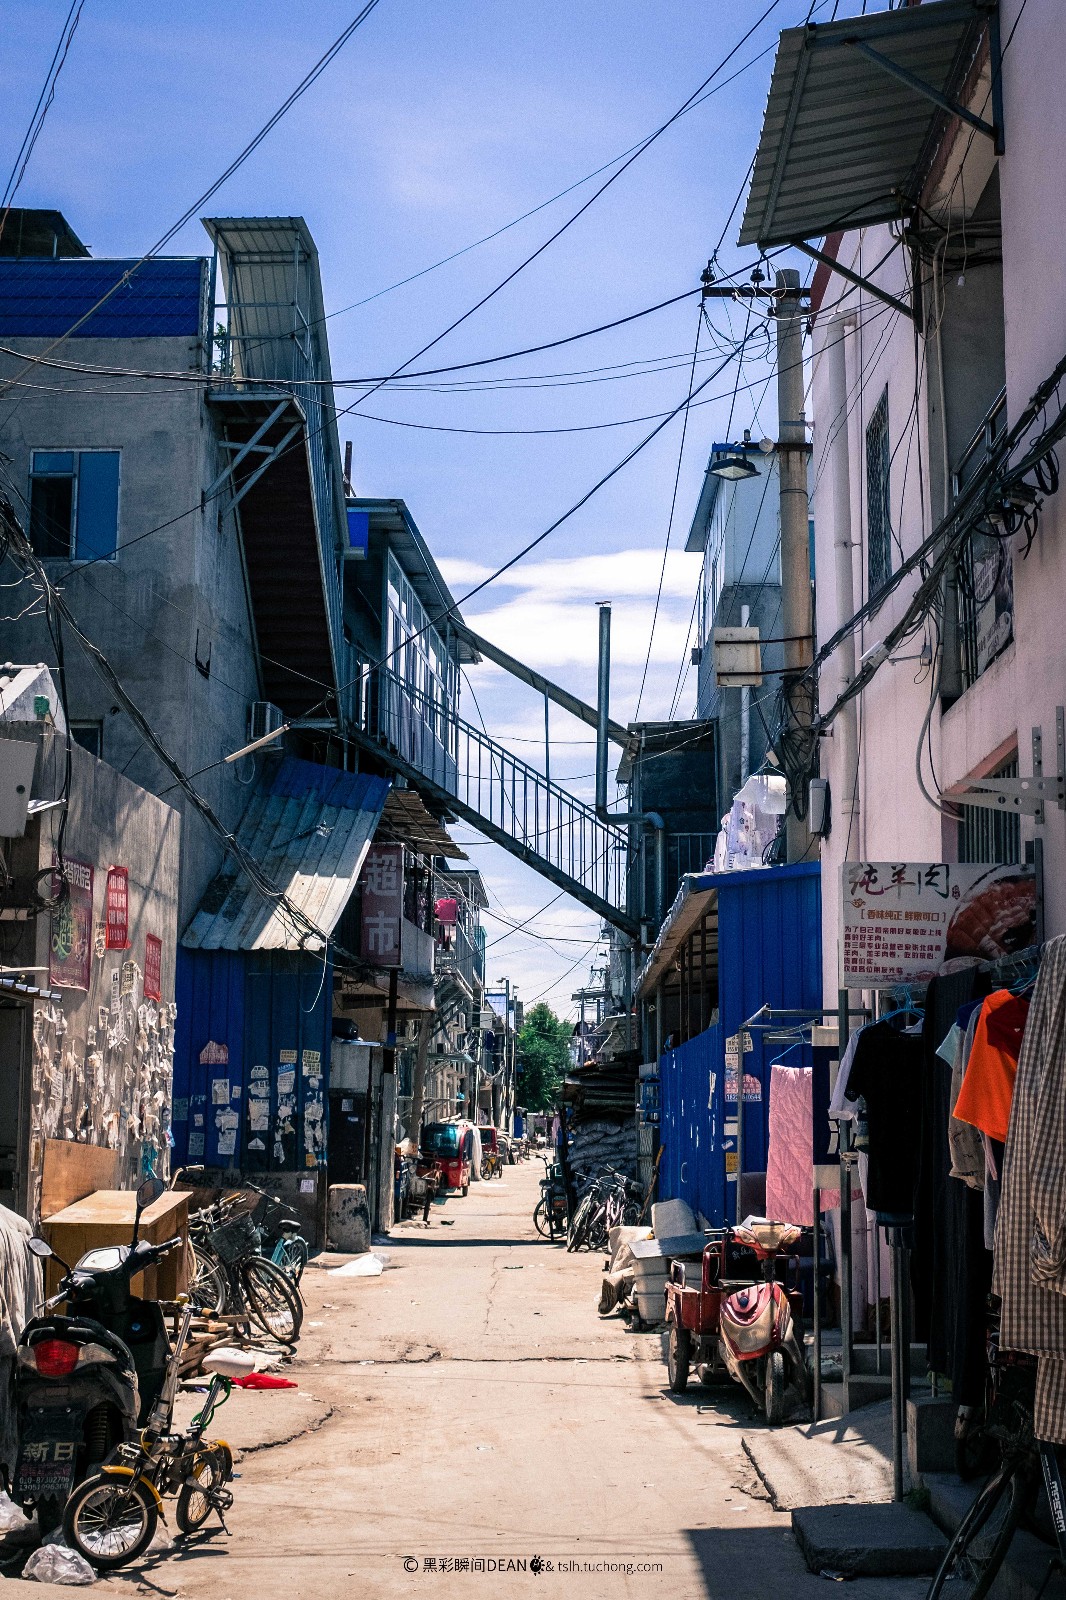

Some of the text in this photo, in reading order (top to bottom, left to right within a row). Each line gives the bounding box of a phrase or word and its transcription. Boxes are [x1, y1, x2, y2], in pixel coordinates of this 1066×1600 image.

[848, 863, 950, 899] 纯羊肉
[364, 851, 400, 956] 超市
[866, 909, 940, 922] 香味纯正 鲜嫩可口
[23, 1442, 75, 1462] 新日
